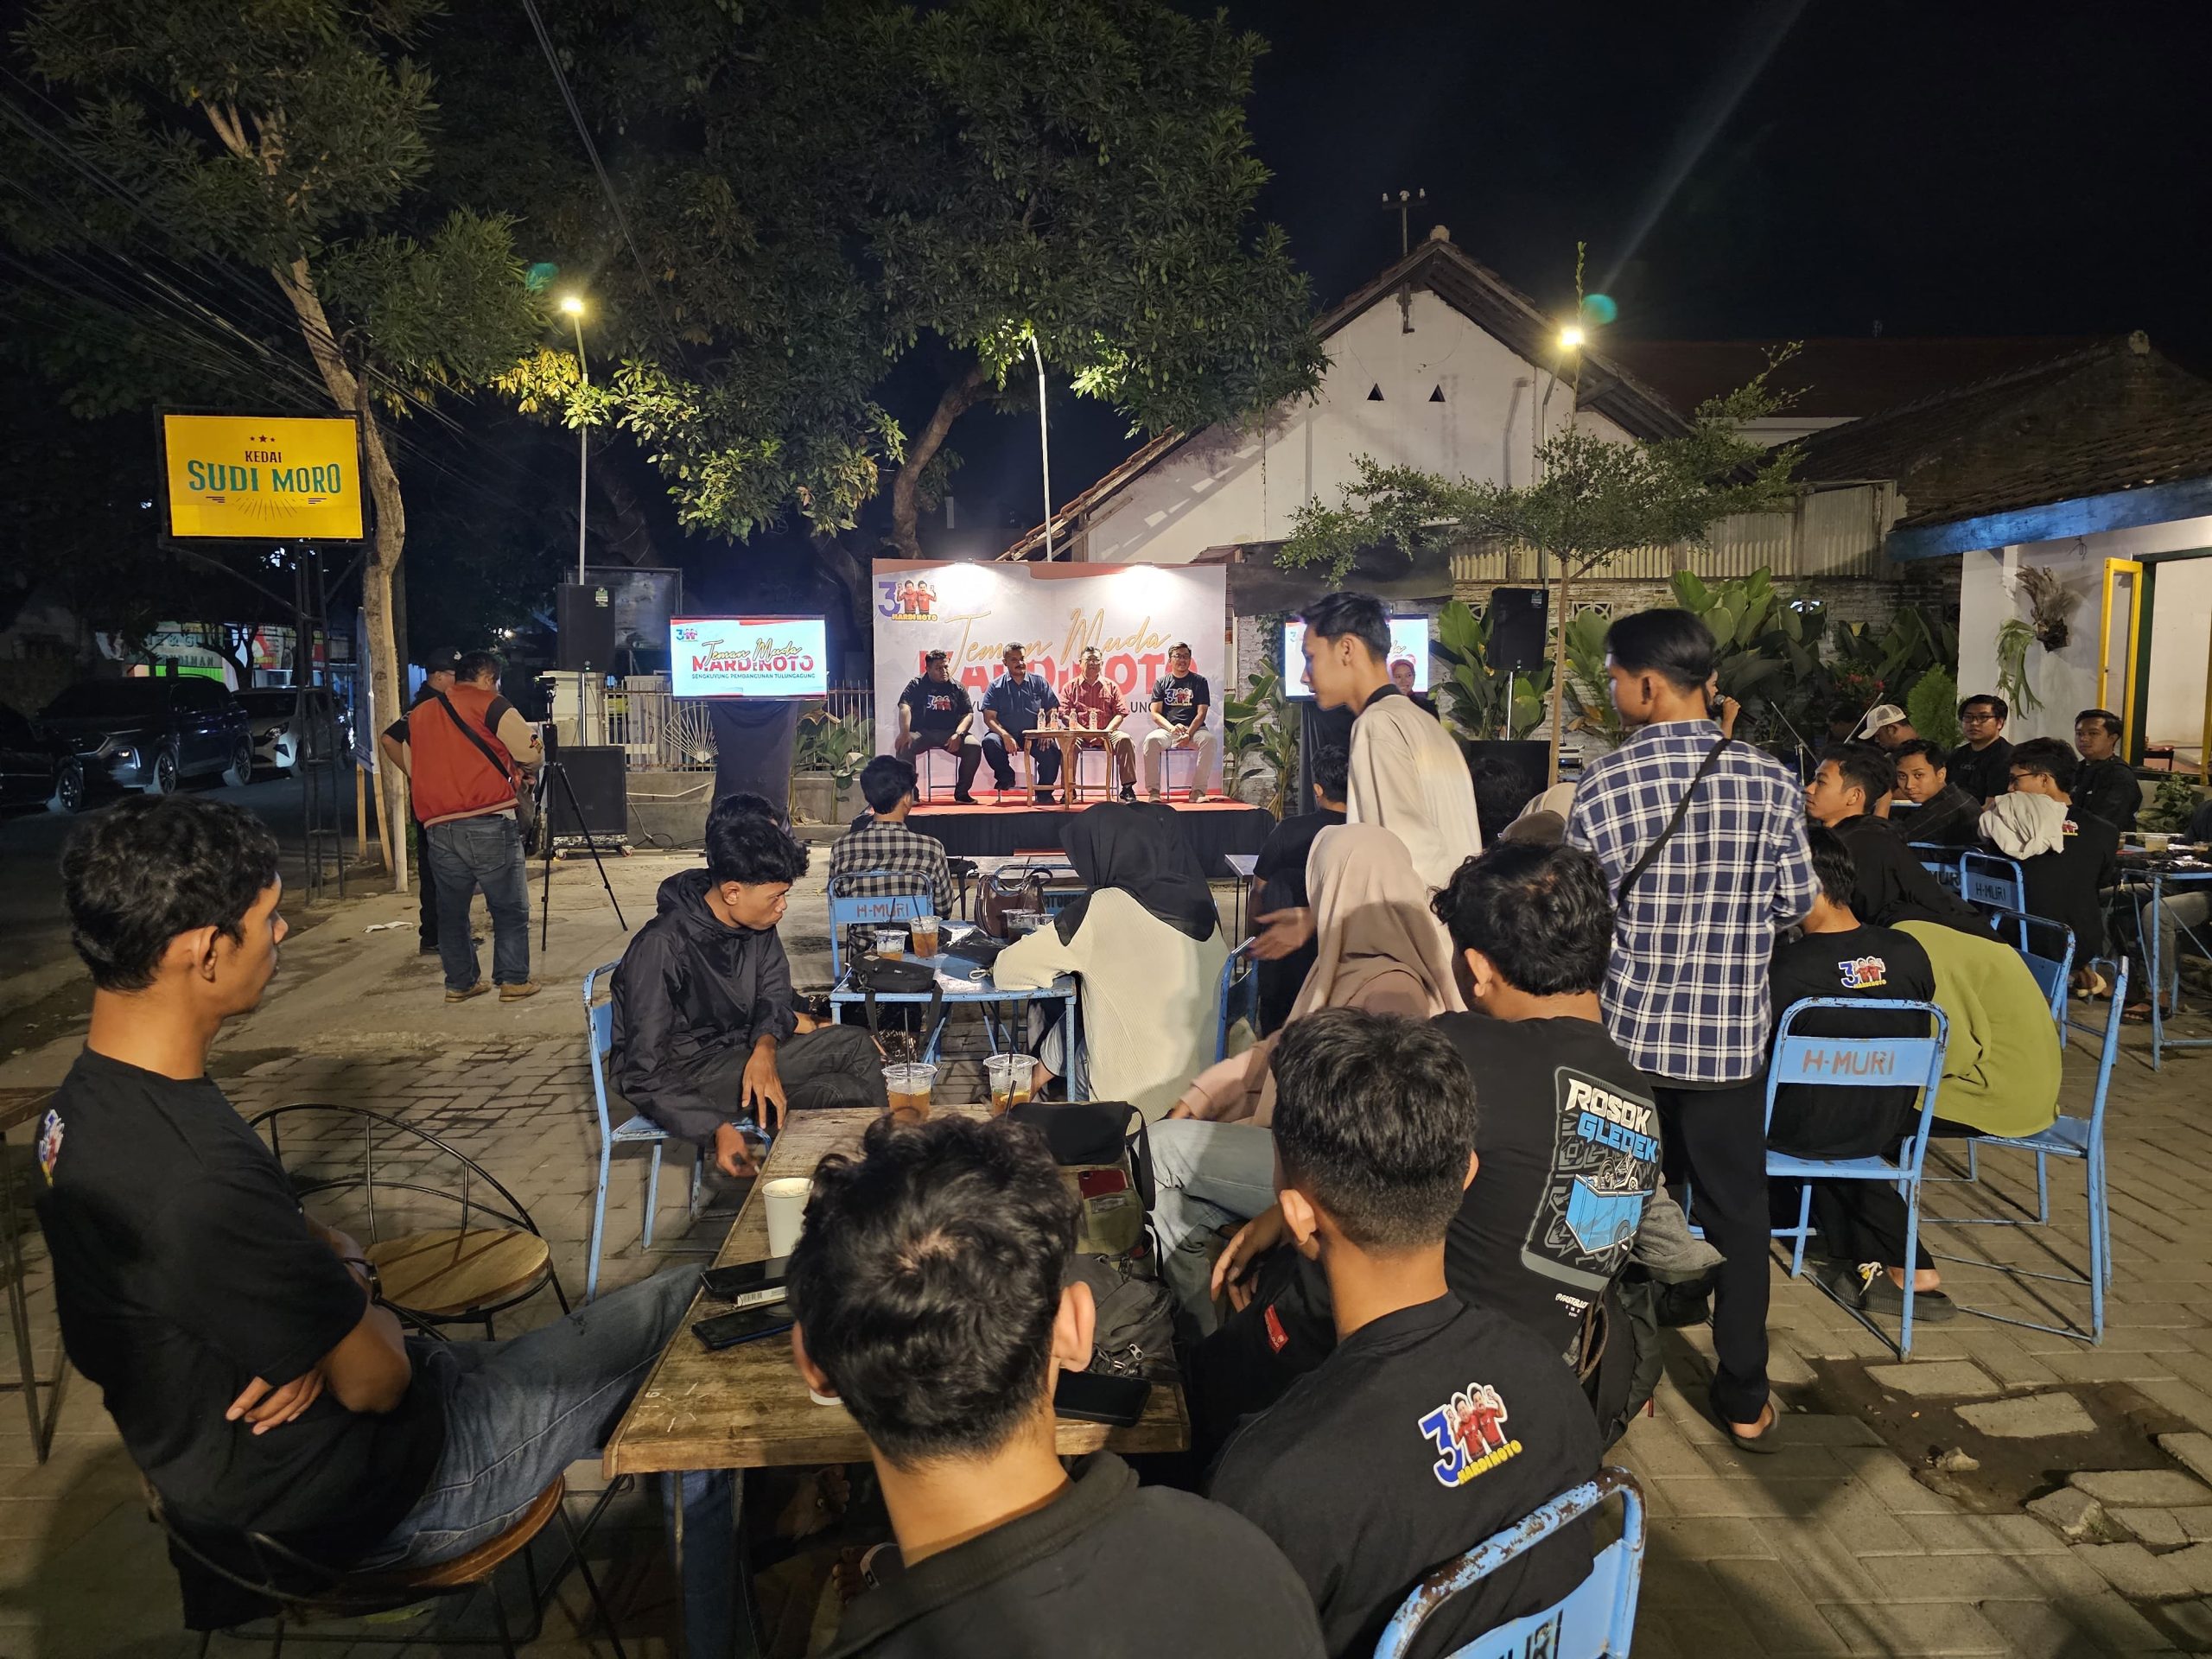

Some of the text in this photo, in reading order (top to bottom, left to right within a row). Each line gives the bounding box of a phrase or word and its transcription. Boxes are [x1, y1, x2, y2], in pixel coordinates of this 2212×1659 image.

[245, 450, 282, 463] KEDAI
[188, 460, 341, 493] SUDI MORO
[878, 581, 901, 617] 3
[701, 638, 803, 666] Teman Muda
[944, 607, 1172, 677] Temn Muda
[692, 655, 814, 672] MARDINOTO
[1975, 882, 2006, 900] H-MURI
[856, 903, 909, 918] H-MURI
[1838, 960, 1860, 988] 3
[1802, 1049, 1895, 1075] H-MURI
[1565, 1077, 1652, 1135] ROSOK
[1577, 1111, 1658, 1164] GLEDEK
[1418, 1403, 1464, 1488] 3
